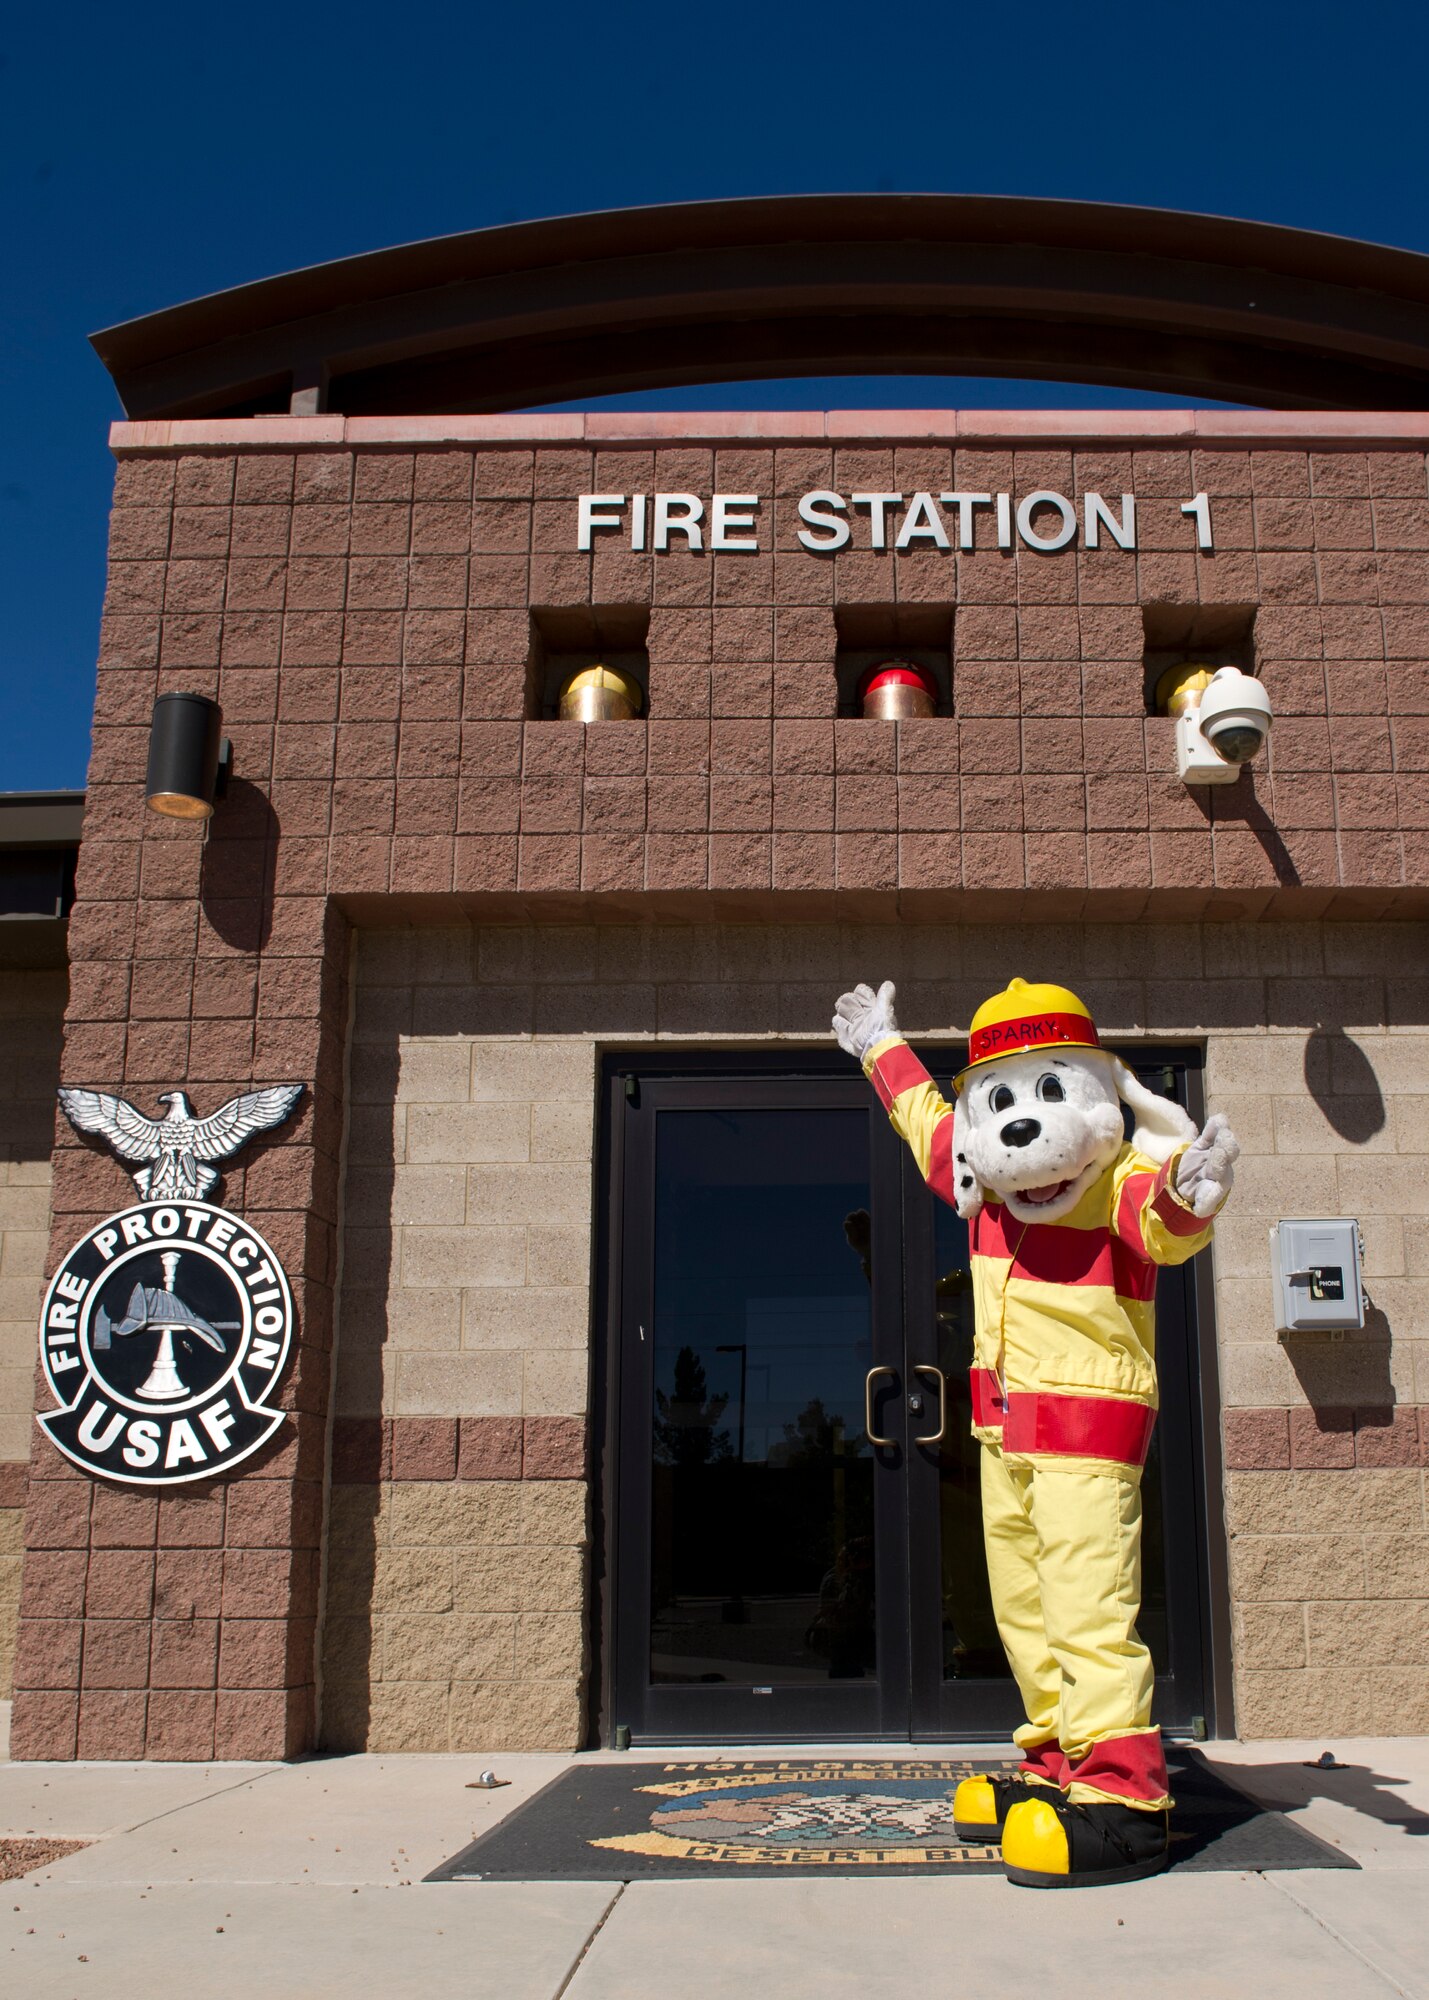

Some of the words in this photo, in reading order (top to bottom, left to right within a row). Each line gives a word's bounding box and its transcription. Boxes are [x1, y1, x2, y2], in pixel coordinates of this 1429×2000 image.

[577, 494, 760, 552] FIRE
[796, 490, 1137, 551] STATION
[1181, 491, 1215, 550] 1
[45, 1271, 91, 1375] FIRE
[92, 1207, 284, 1371] PROTECTION
[77, 1398, 237, 1470] USAF
[663, 1762, 973, 1772] HOLLOMAN
[686, 1846, 897, 1862] DESERT
